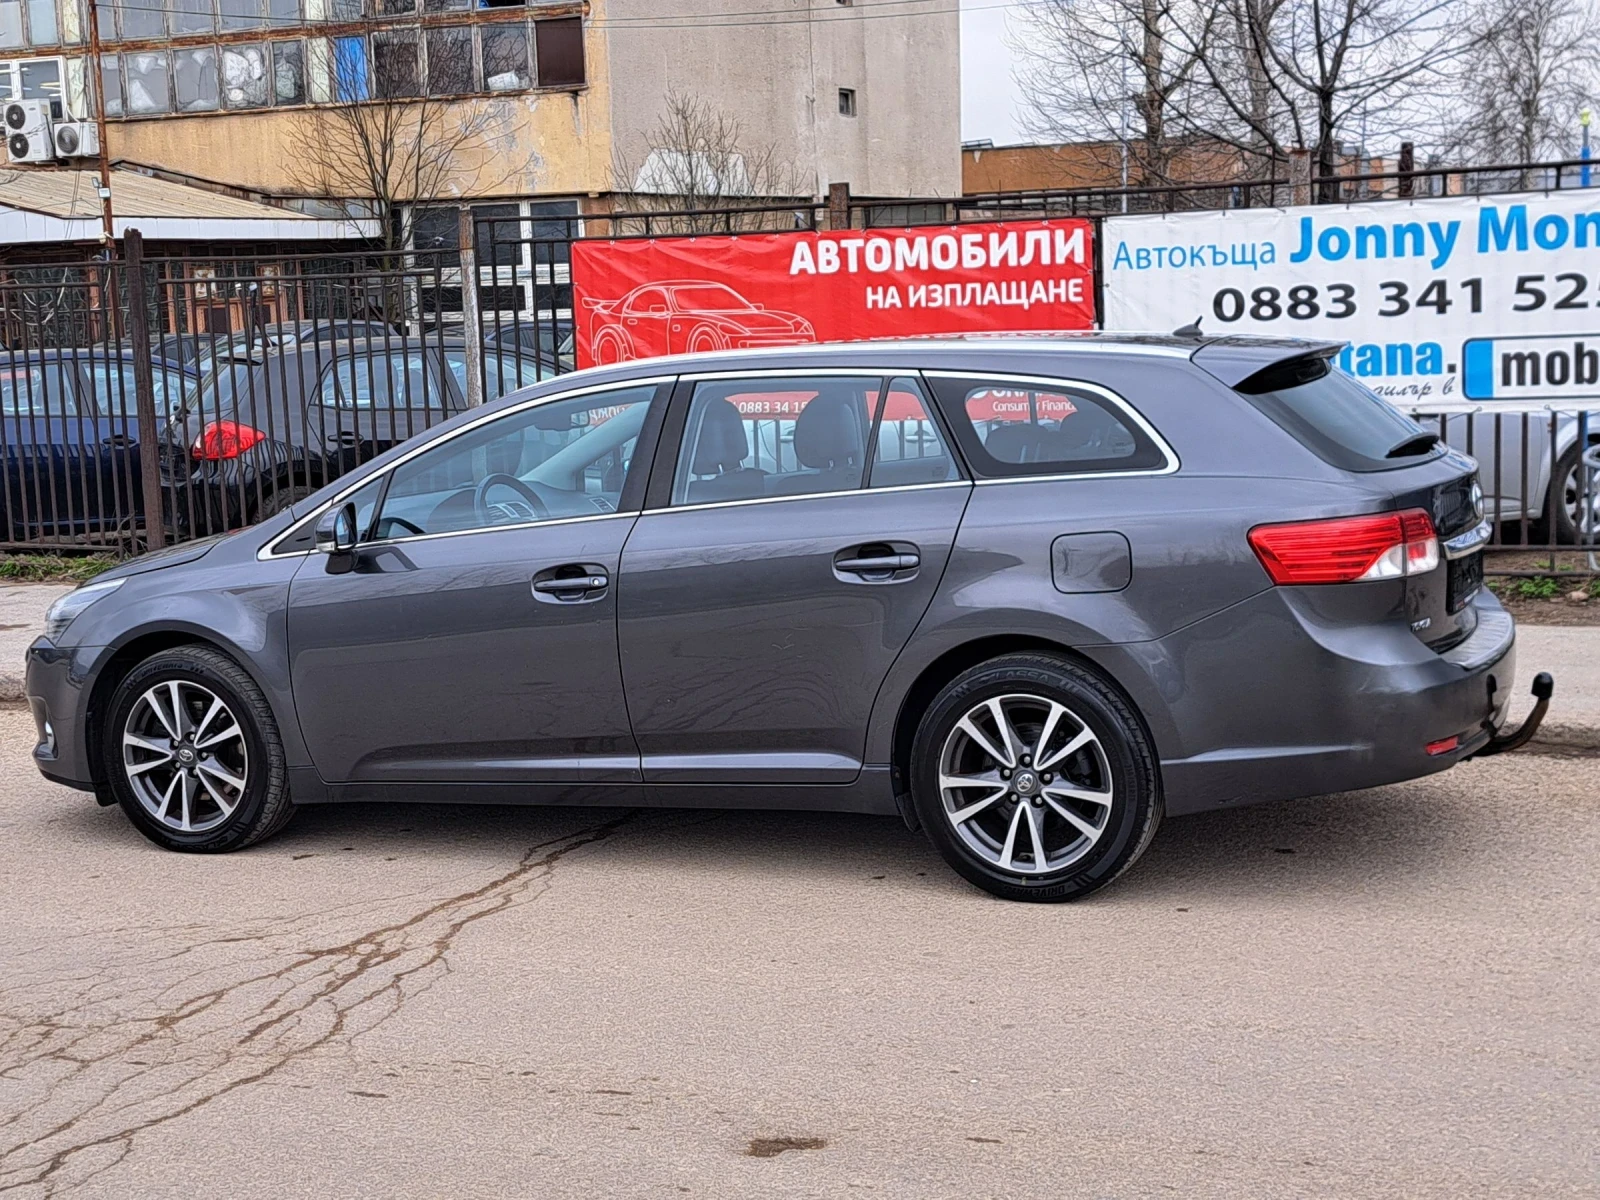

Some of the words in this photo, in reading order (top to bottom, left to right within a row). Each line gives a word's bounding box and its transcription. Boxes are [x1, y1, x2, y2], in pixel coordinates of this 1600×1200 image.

[789, 228, 1085, 275] АВТОМОБИЛИ
[1112, 241, 1275, 270] Автокъща
[1290, 216, 1461, 270] Jonny
[866, 286, 902, 309] НА
[908, 278, 1083, 310] ИЗПЛАЩАНЕ
[1213, 283, 1357, 322] 0883
[1378, 277, 1482, 317] 341
[1512, 273, 1600, 312] 52
[1331, 341, 1457, 378] tana.
[738, 401, 770, 413] 0883
[773, 401, 789, 413] 34
[992, 401, 1040, 412] Consumr
[1042, 400, 1075, 411] Financ
